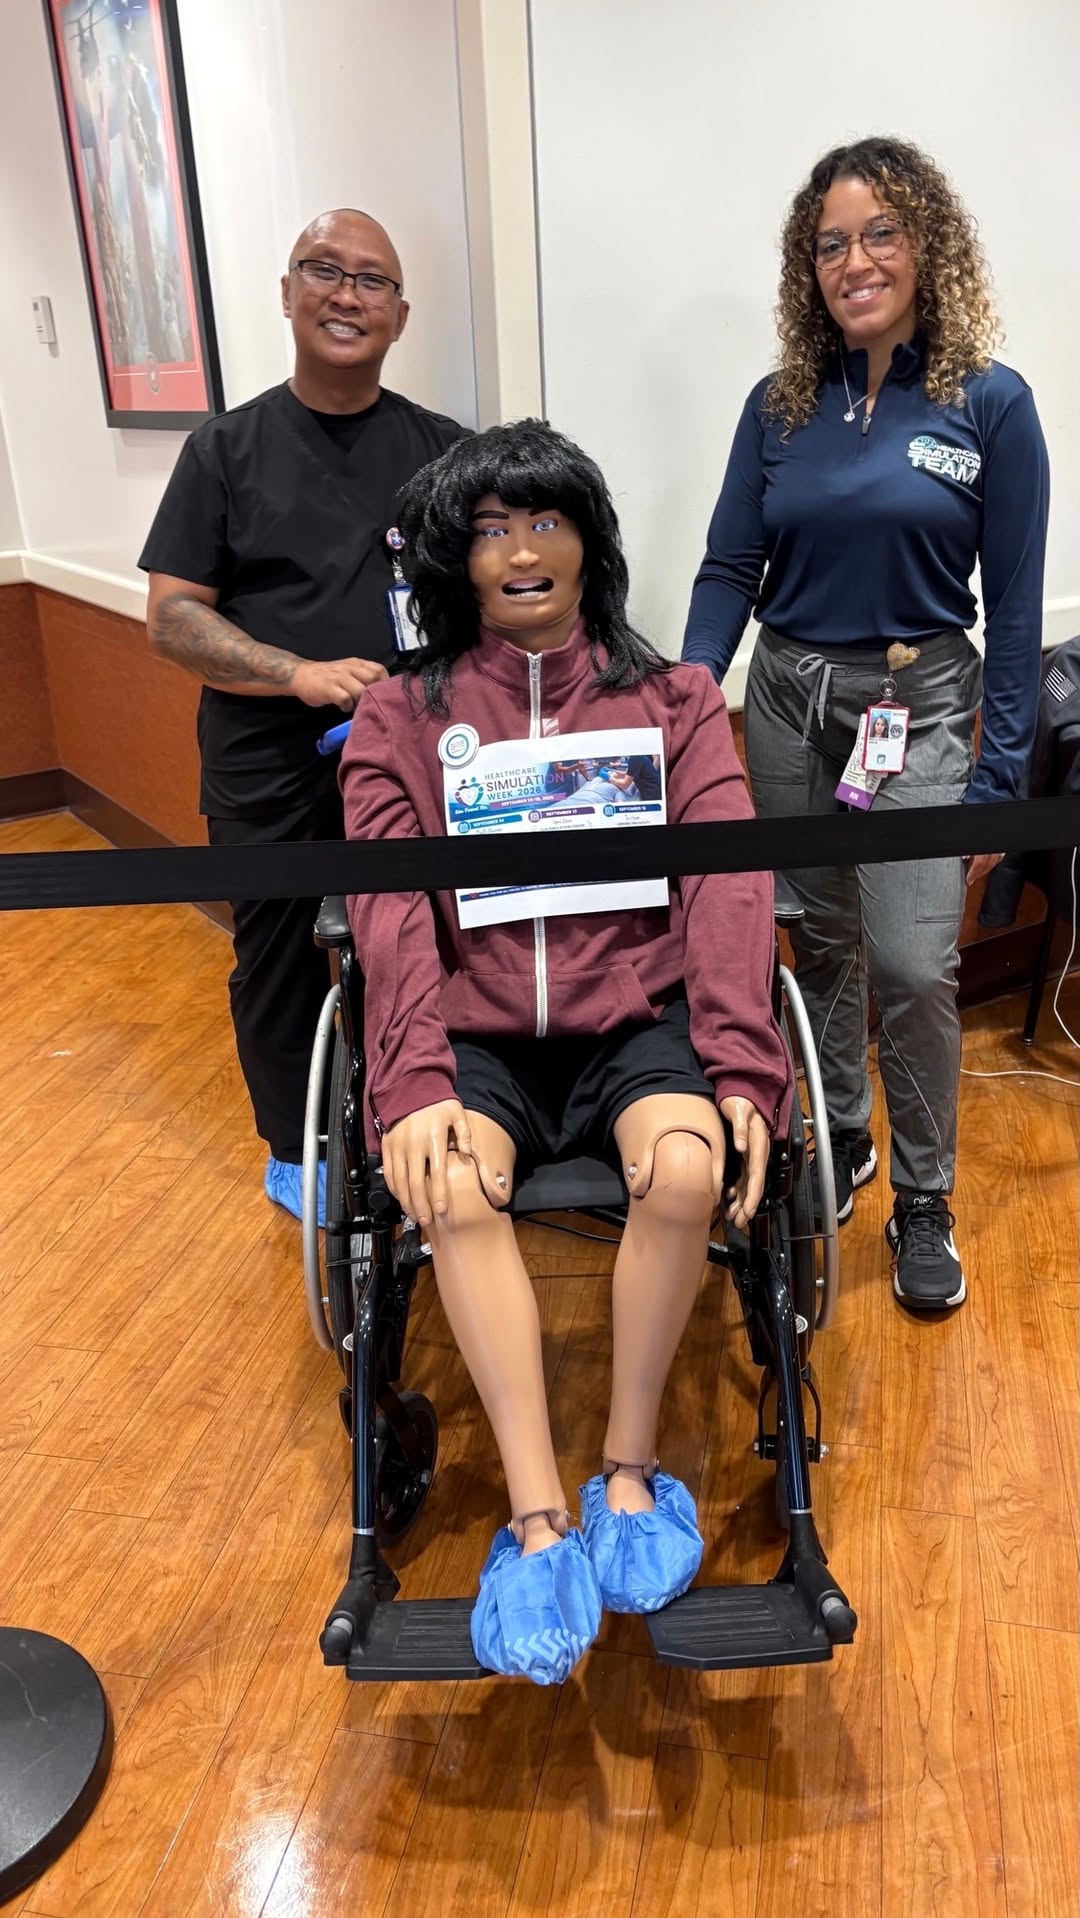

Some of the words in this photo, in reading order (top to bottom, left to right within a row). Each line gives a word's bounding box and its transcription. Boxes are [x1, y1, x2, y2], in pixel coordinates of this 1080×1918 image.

[907, 441, 981, 470] SIMULATION
[907, 453, 978, 485] TEAM
[484, 767, 537, 780] HEALTHCARE
[486, 773, 564, 792] SIMULATION
[487, 790, 513, 801] WEEK
[518, 786, 542, 796] 2026
[501, 798, 527, 807] SEPTEMBER
[472, 819, 499, 827] SEPTEMBER
